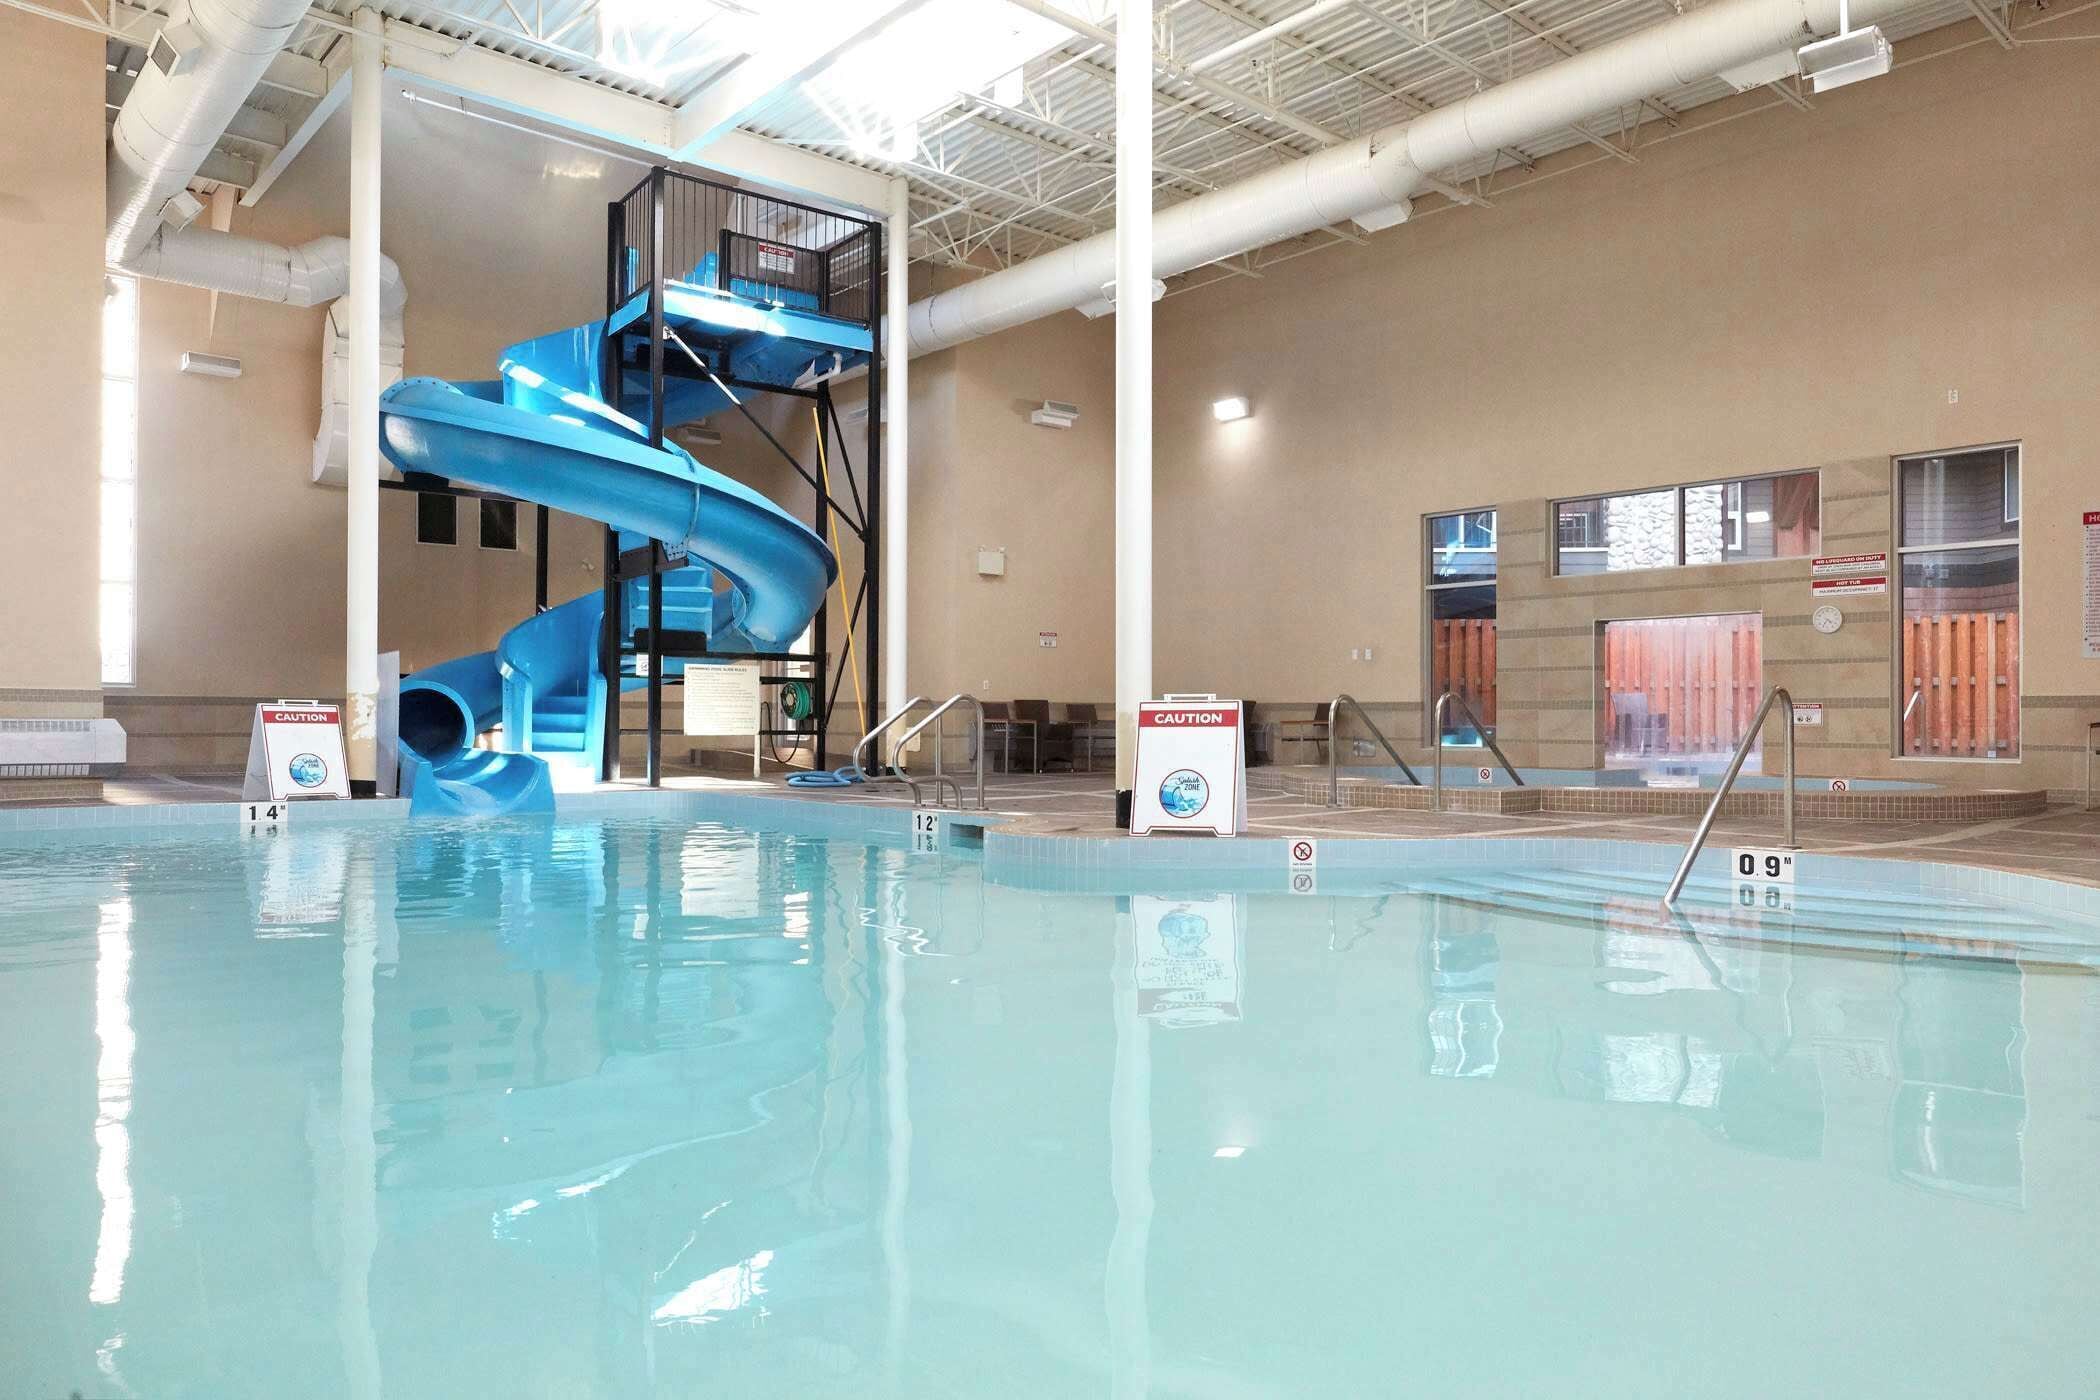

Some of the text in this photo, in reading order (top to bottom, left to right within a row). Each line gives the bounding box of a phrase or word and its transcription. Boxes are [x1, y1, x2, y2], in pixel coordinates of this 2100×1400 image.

[275, 713, 327, 722] CAUTION
[1154, 713, 1222, 723] CAUTION
[1184, 783, 1201, 791] ZONE
